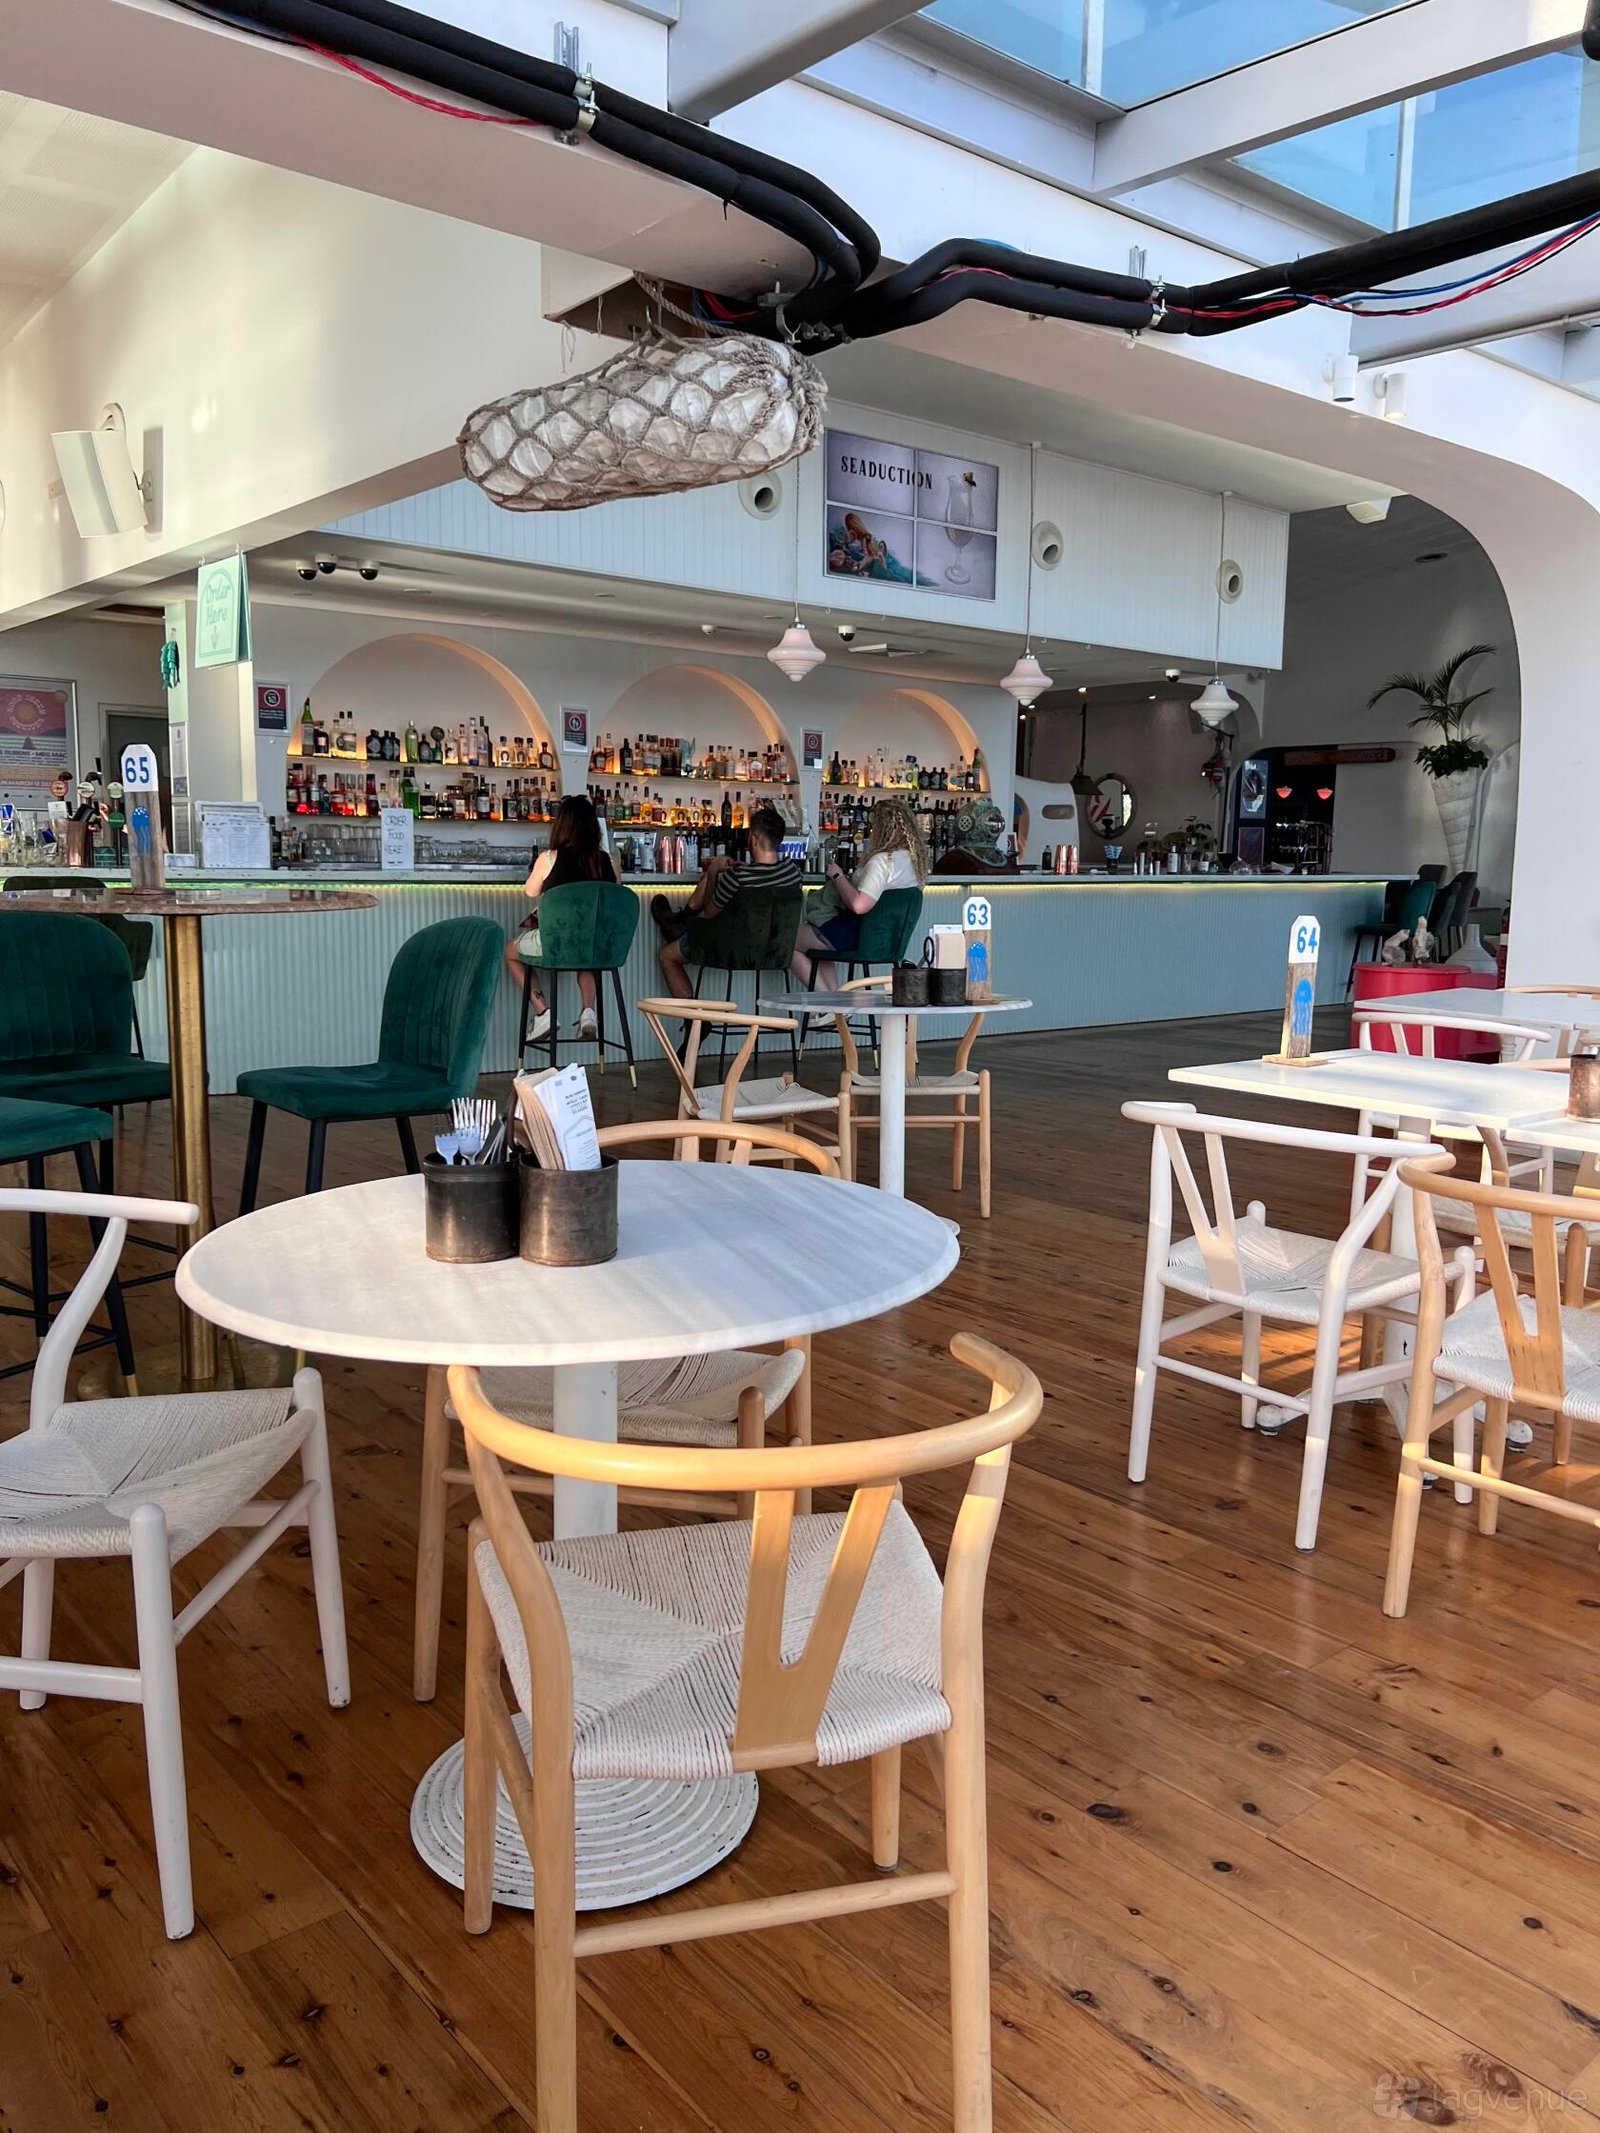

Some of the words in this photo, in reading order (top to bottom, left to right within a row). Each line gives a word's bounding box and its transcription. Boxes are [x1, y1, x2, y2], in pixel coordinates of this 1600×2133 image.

[840, 455, 933, 490] SEADUCTION
[205, 580, 232, 605] Order
[125, 756, 150, 783] 65
[385, 815, 408, 826] ORDER
[386, 828, 405, 840] FOOD
[967, 903, 988, 926] 63
[1296, 925, 1318, 953] 64
